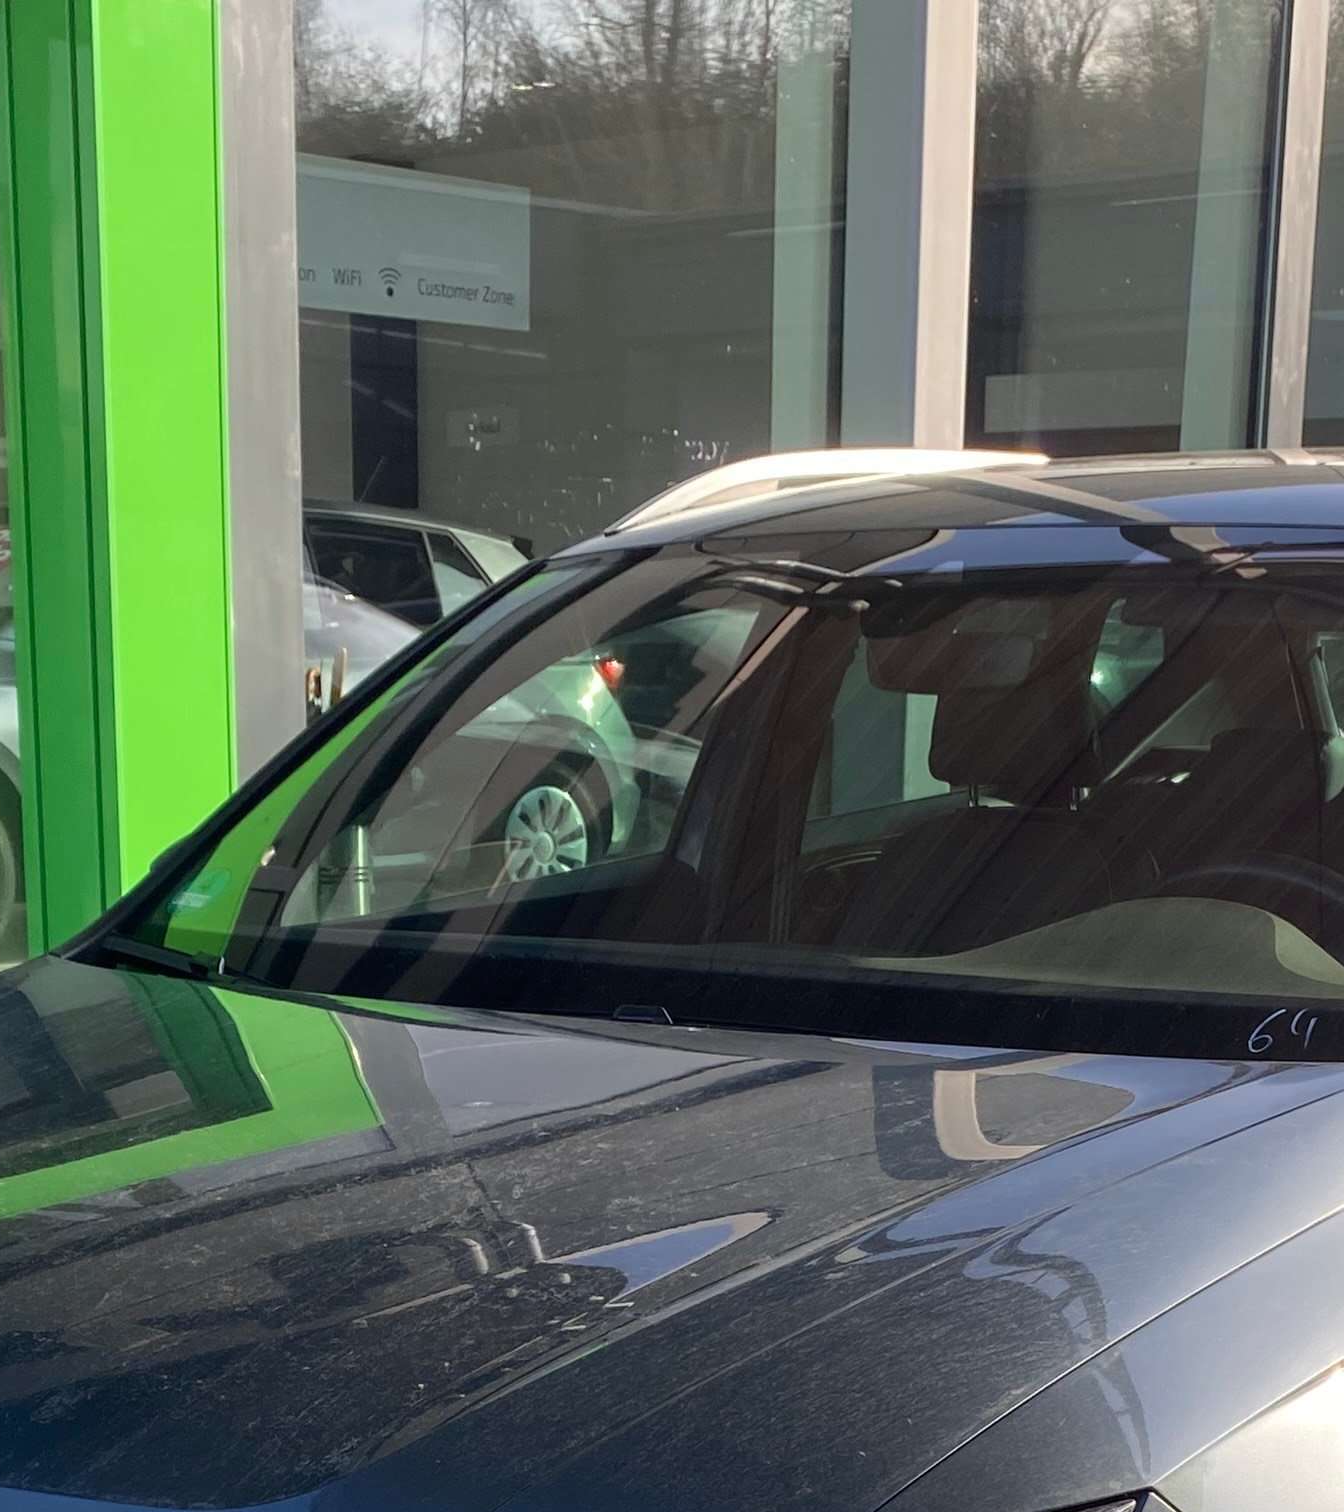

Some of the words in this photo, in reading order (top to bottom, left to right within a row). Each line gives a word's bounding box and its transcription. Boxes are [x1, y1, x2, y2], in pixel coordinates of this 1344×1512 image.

[333, 267, 362, 287] WiFi
[417, 277, 479, 302] Customer
[482, 285, 514, 306] Zone
